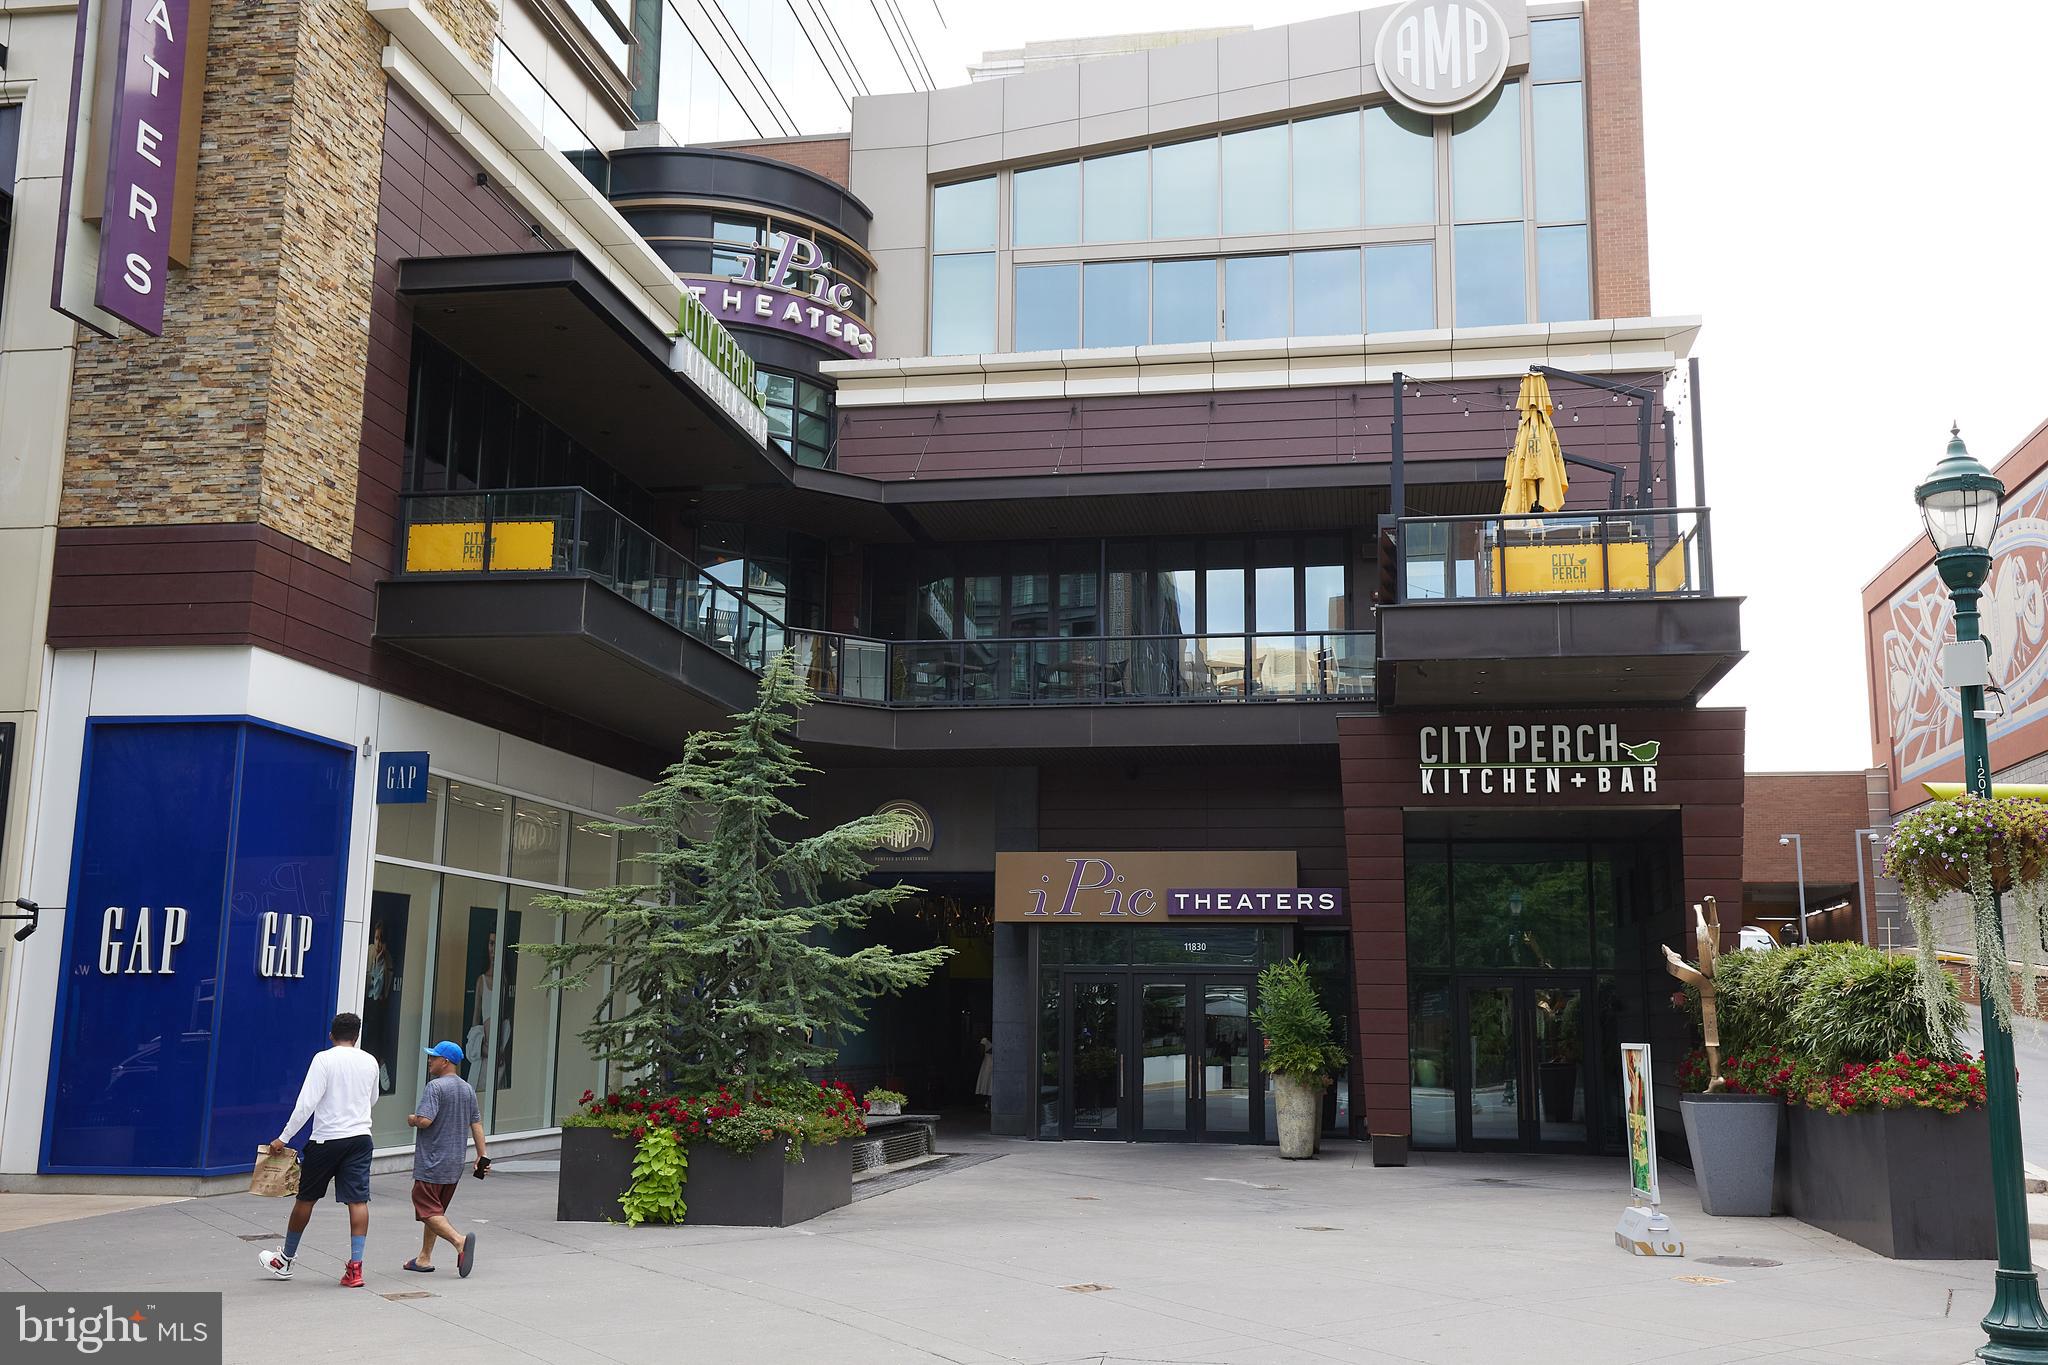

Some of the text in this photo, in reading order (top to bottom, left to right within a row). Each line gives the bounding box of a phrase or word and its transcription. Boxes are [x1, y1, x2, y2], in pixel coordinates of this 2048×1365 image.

[1397, 4, 1488, 90] AMP
[121, 0, 174, 295] ATERS
[730, 231, 854, 312] iPic
[679, 292, 756, 402] CITY PERCH
[688, 286, 873, 354] THEATERS
[1551, 553, 1575, 566] CITY
[1552, 566, 1587, 580] PERCH
[1420, 723, 1619, 764] CITY PERCH
[386, 765, 417, 789] GAP
[1024, 858, 1157, 917] iPic
[1174, 893, 1336, 911] THEATERS
[99, 907, 187, 975] GAP
[261, 911, 313, 978] GAP
[1184, 941, 1207, 953] 11830
